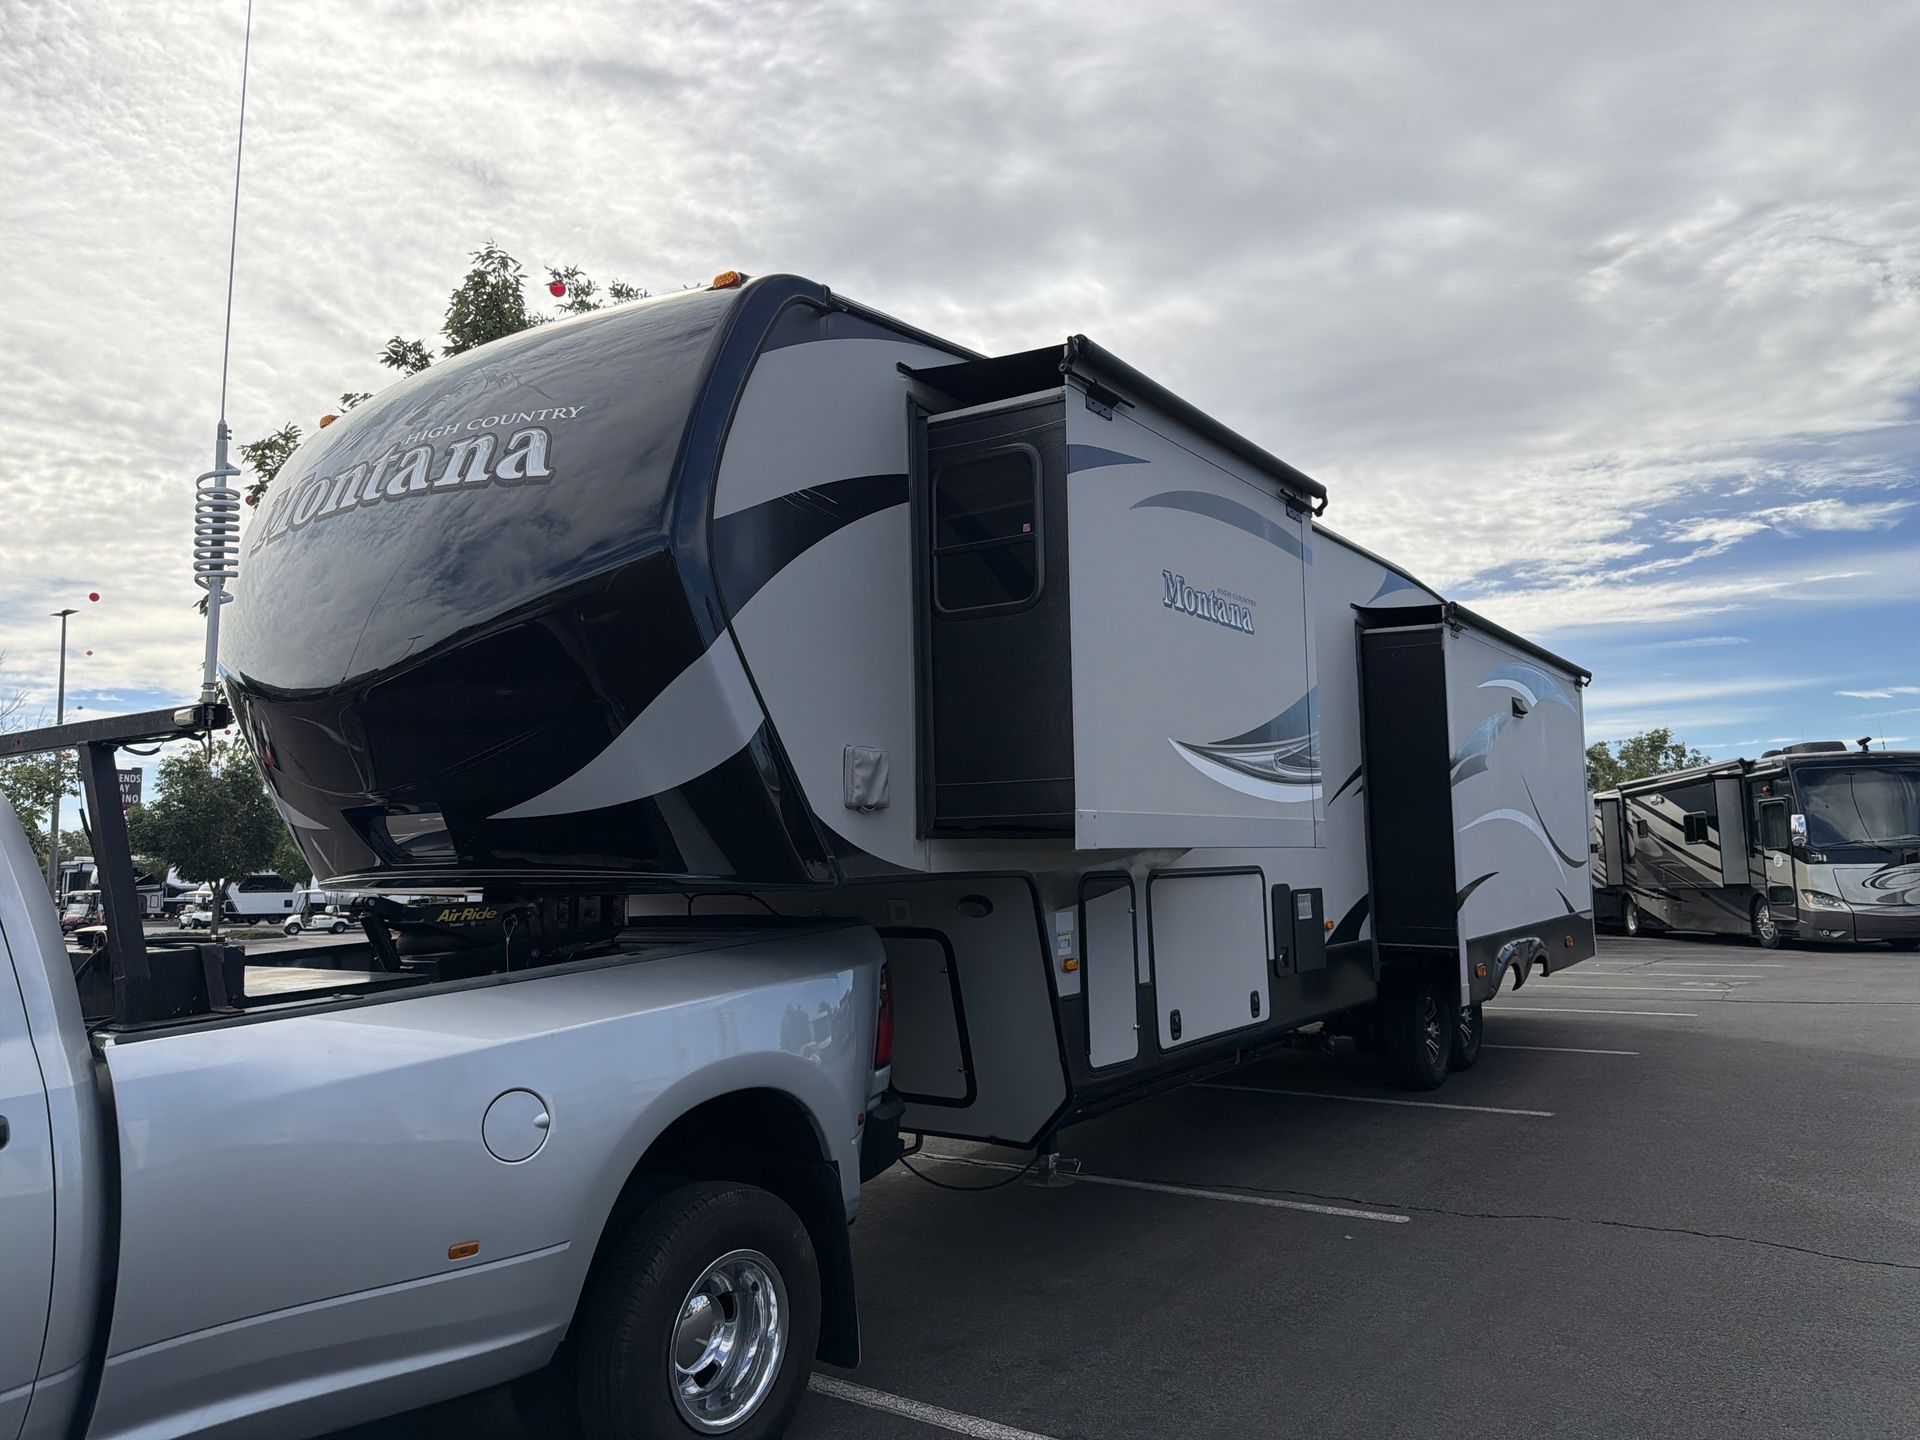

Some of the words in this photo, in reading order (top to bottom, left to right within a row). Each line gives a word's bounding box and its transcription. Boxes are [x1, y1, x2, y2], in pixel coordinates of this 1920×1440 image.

[405, 423, 460, 445] HIGH
[466, 405, 587, 430] COUNTRY
[249, 425, 557, 558] Montana
[1162, 569, 1255, 635] Montana
[118, 773, 141, 783] ENDS
[119, 784, 130, 793] AY
[121, 793, 139, 803] INO
